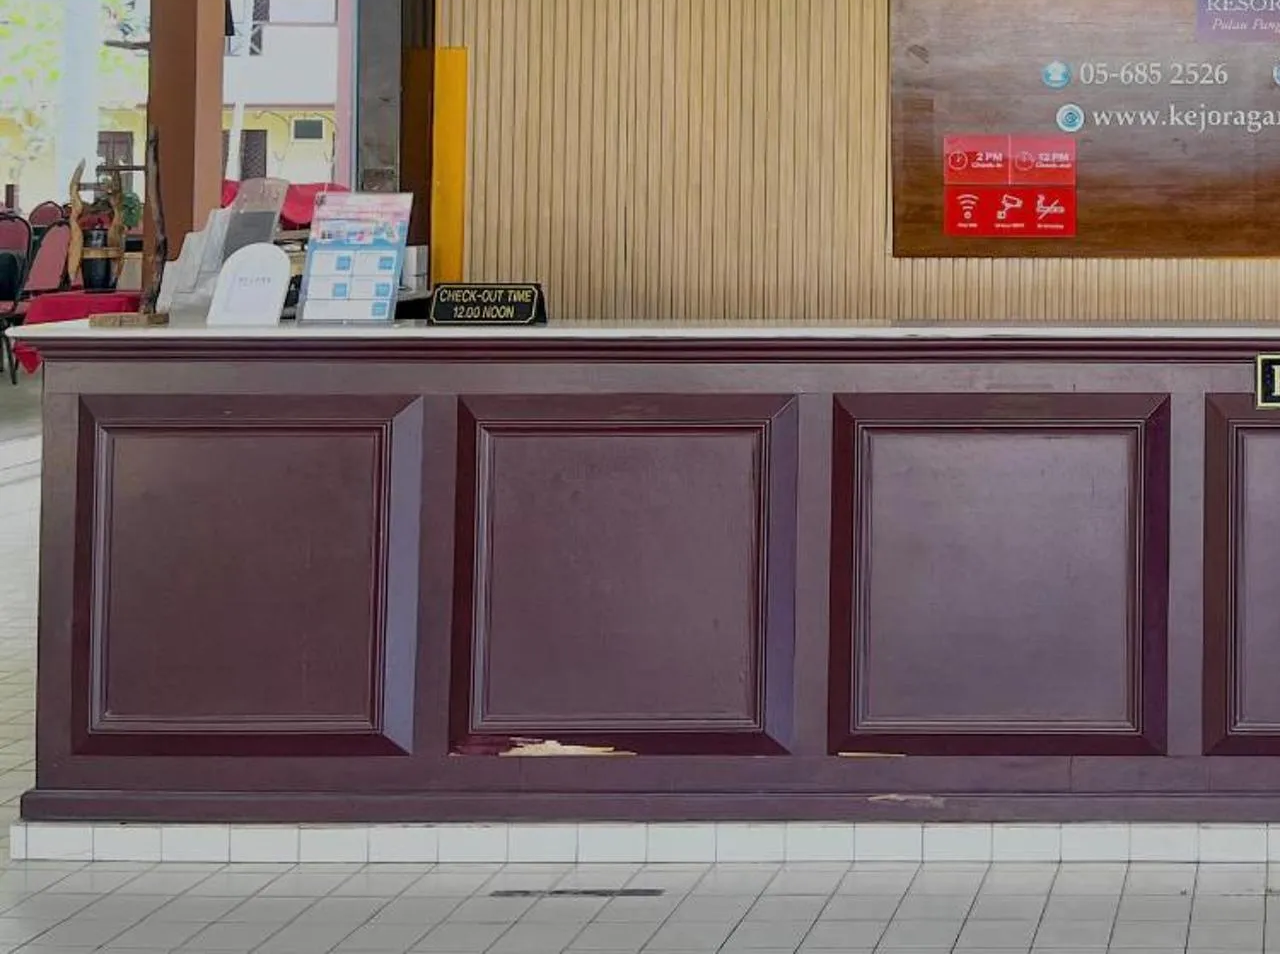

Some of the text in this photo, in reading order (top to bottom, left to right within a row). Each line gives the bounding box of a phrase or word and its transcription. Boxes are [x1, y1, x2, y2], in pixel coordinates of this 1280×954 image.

[1079, 62, 1229, 85] 05-685 2526
[985, 151, 1003, 162] PM
[440, 289, 532, 303] CHECK-OUT TIME
[453, 305, 515, 319] 12.00 NOON
